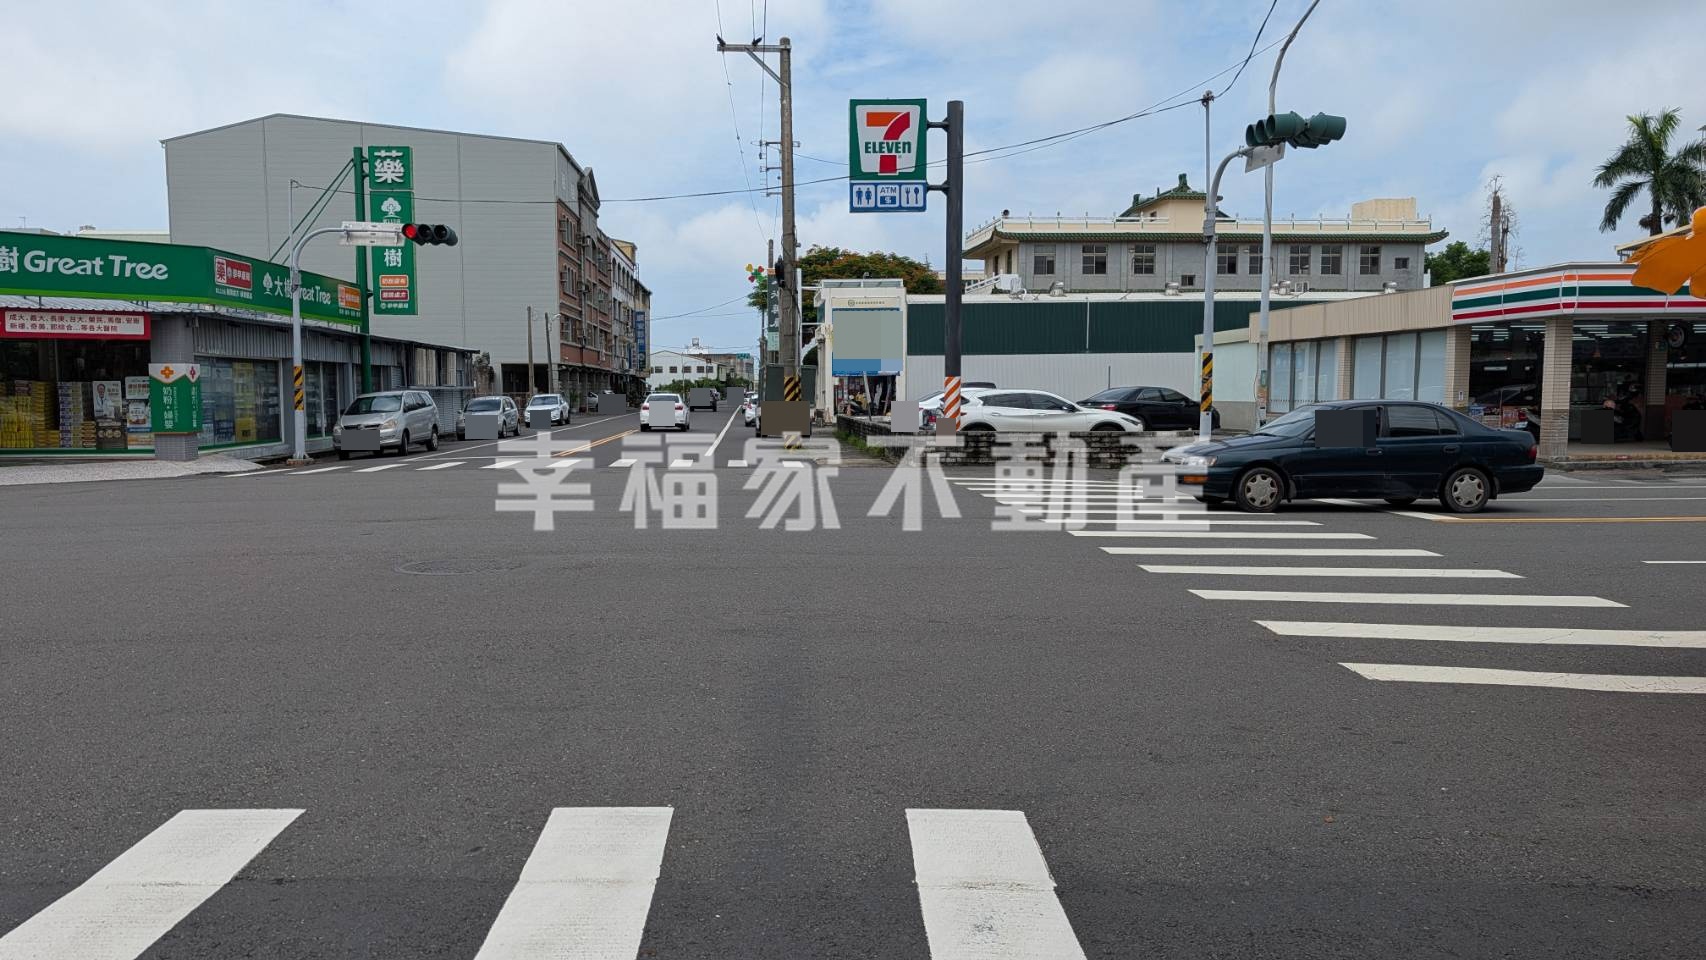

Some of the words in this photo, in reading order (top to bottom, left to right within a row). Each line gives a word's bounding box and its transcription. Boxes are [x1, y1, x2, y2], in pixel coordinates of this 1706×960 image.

[373, 149, 405, 184] 藥
[879, 186, 897, 194] ATM
[23, 250, 104, 276] Great
[108, 255, 169, 280] Tree
[314, 285, 331, 305] Tree
